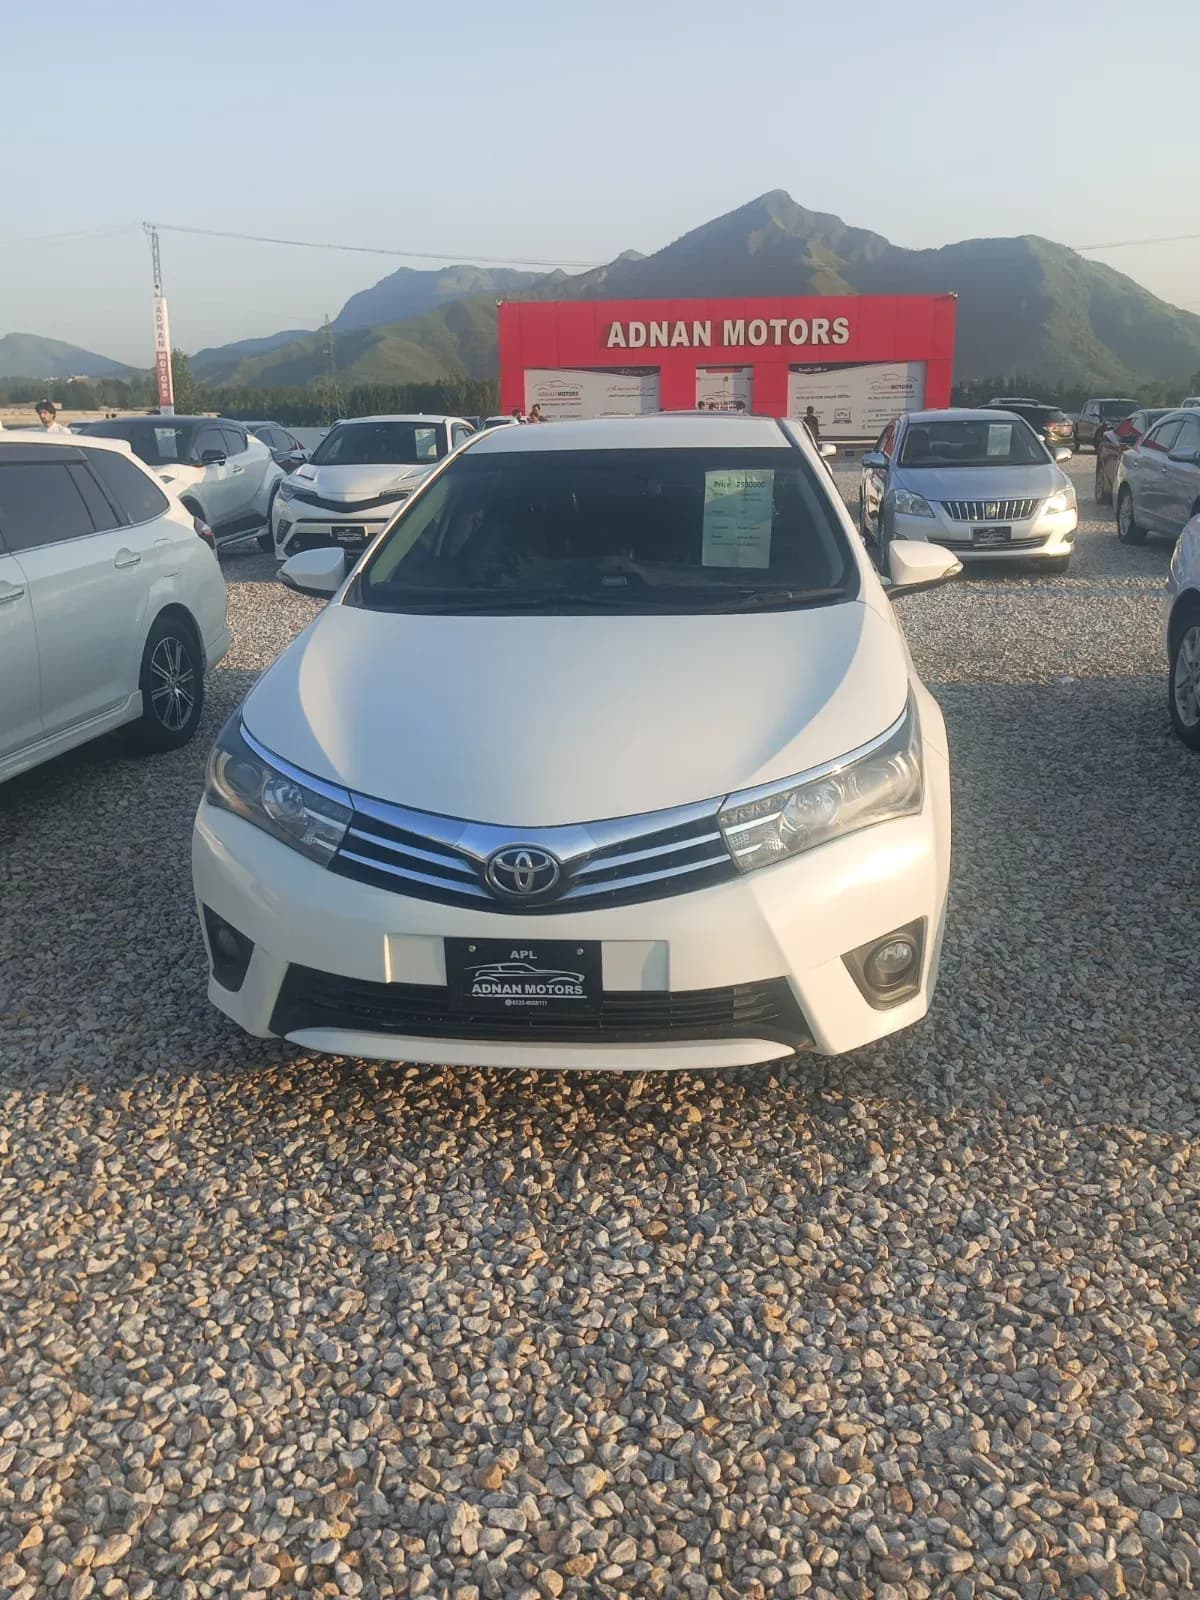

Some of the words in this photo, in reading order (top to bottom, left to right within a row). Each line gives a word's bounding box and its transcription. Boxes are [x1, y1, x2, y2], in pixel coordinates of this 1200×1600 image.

[607, 321, 712, 348] ADNAN
[723, 317, 850, 346] MOTORS
[159, 353, 168, 397] MOTORS
[510, 950, 538, 960] APL
[472, 984, 521, 994] ADNAN
[525, 984, 583, 995] MOTORS
